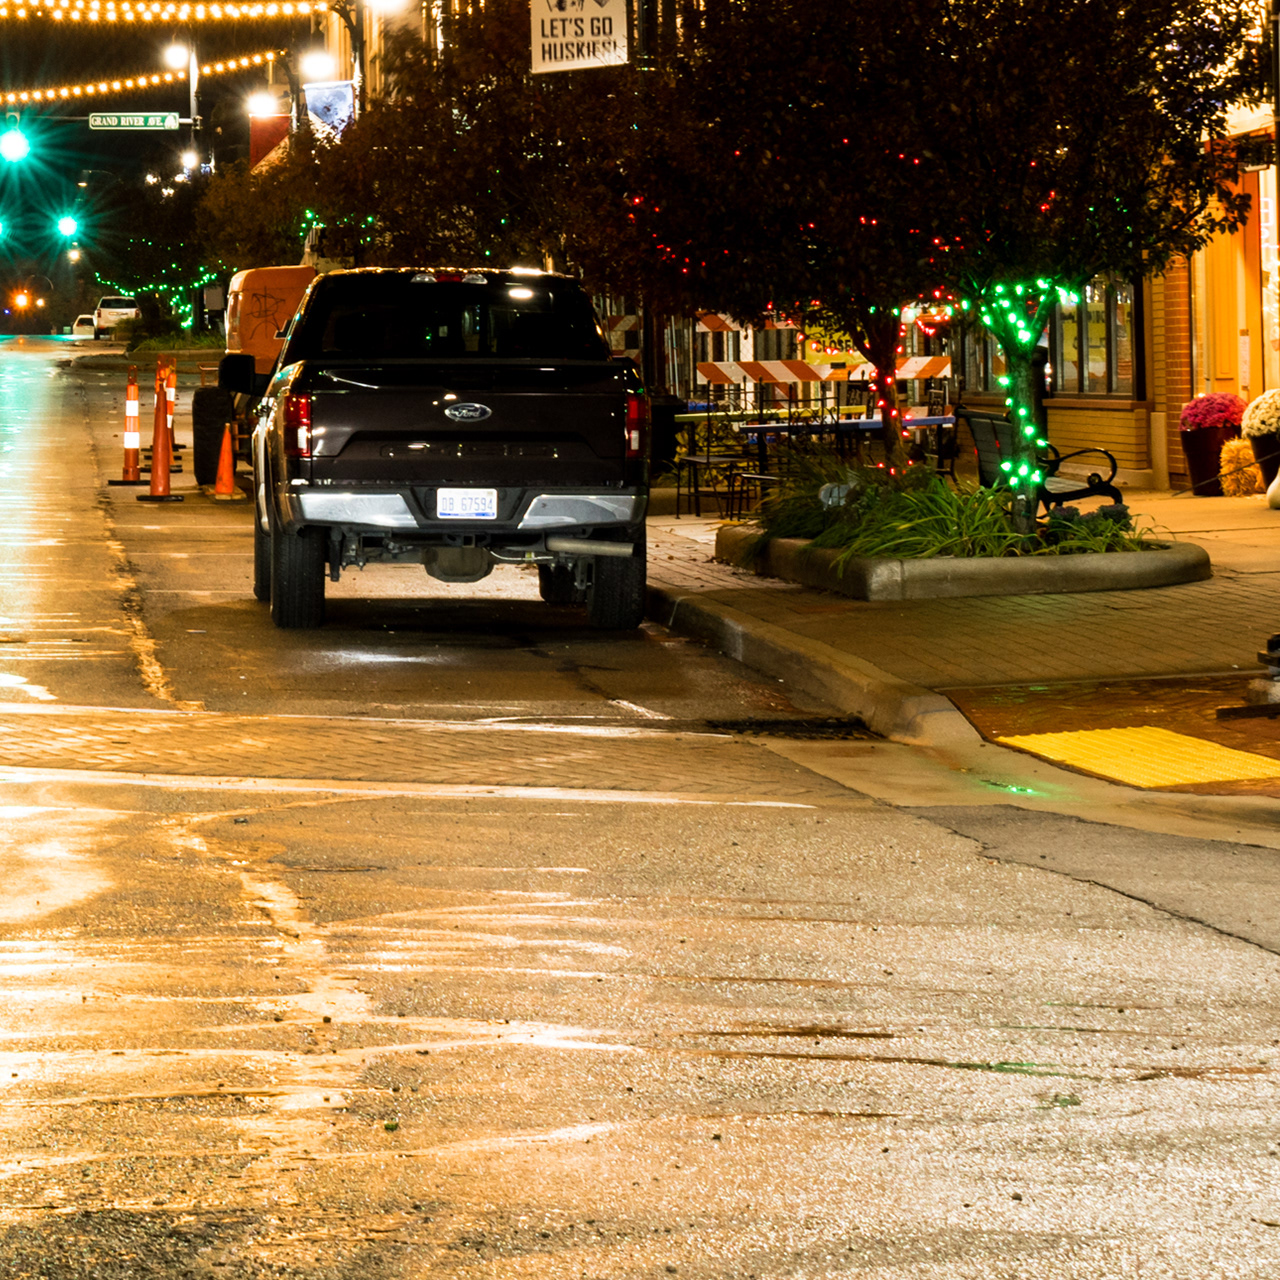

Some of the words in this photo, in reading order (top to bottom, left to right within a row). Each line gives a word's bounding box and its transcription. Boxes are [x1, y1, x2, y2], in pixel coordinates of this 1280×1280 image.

[541, 17, 584, 38] LET'S
[590, 16, 612, 37] GO
[91, 116, 118, 126] GRAND
[120, 116, 144, 126] RIVER
[147, 116, 163, 126] AVE.
[461, 497, 493, 511] 67594
